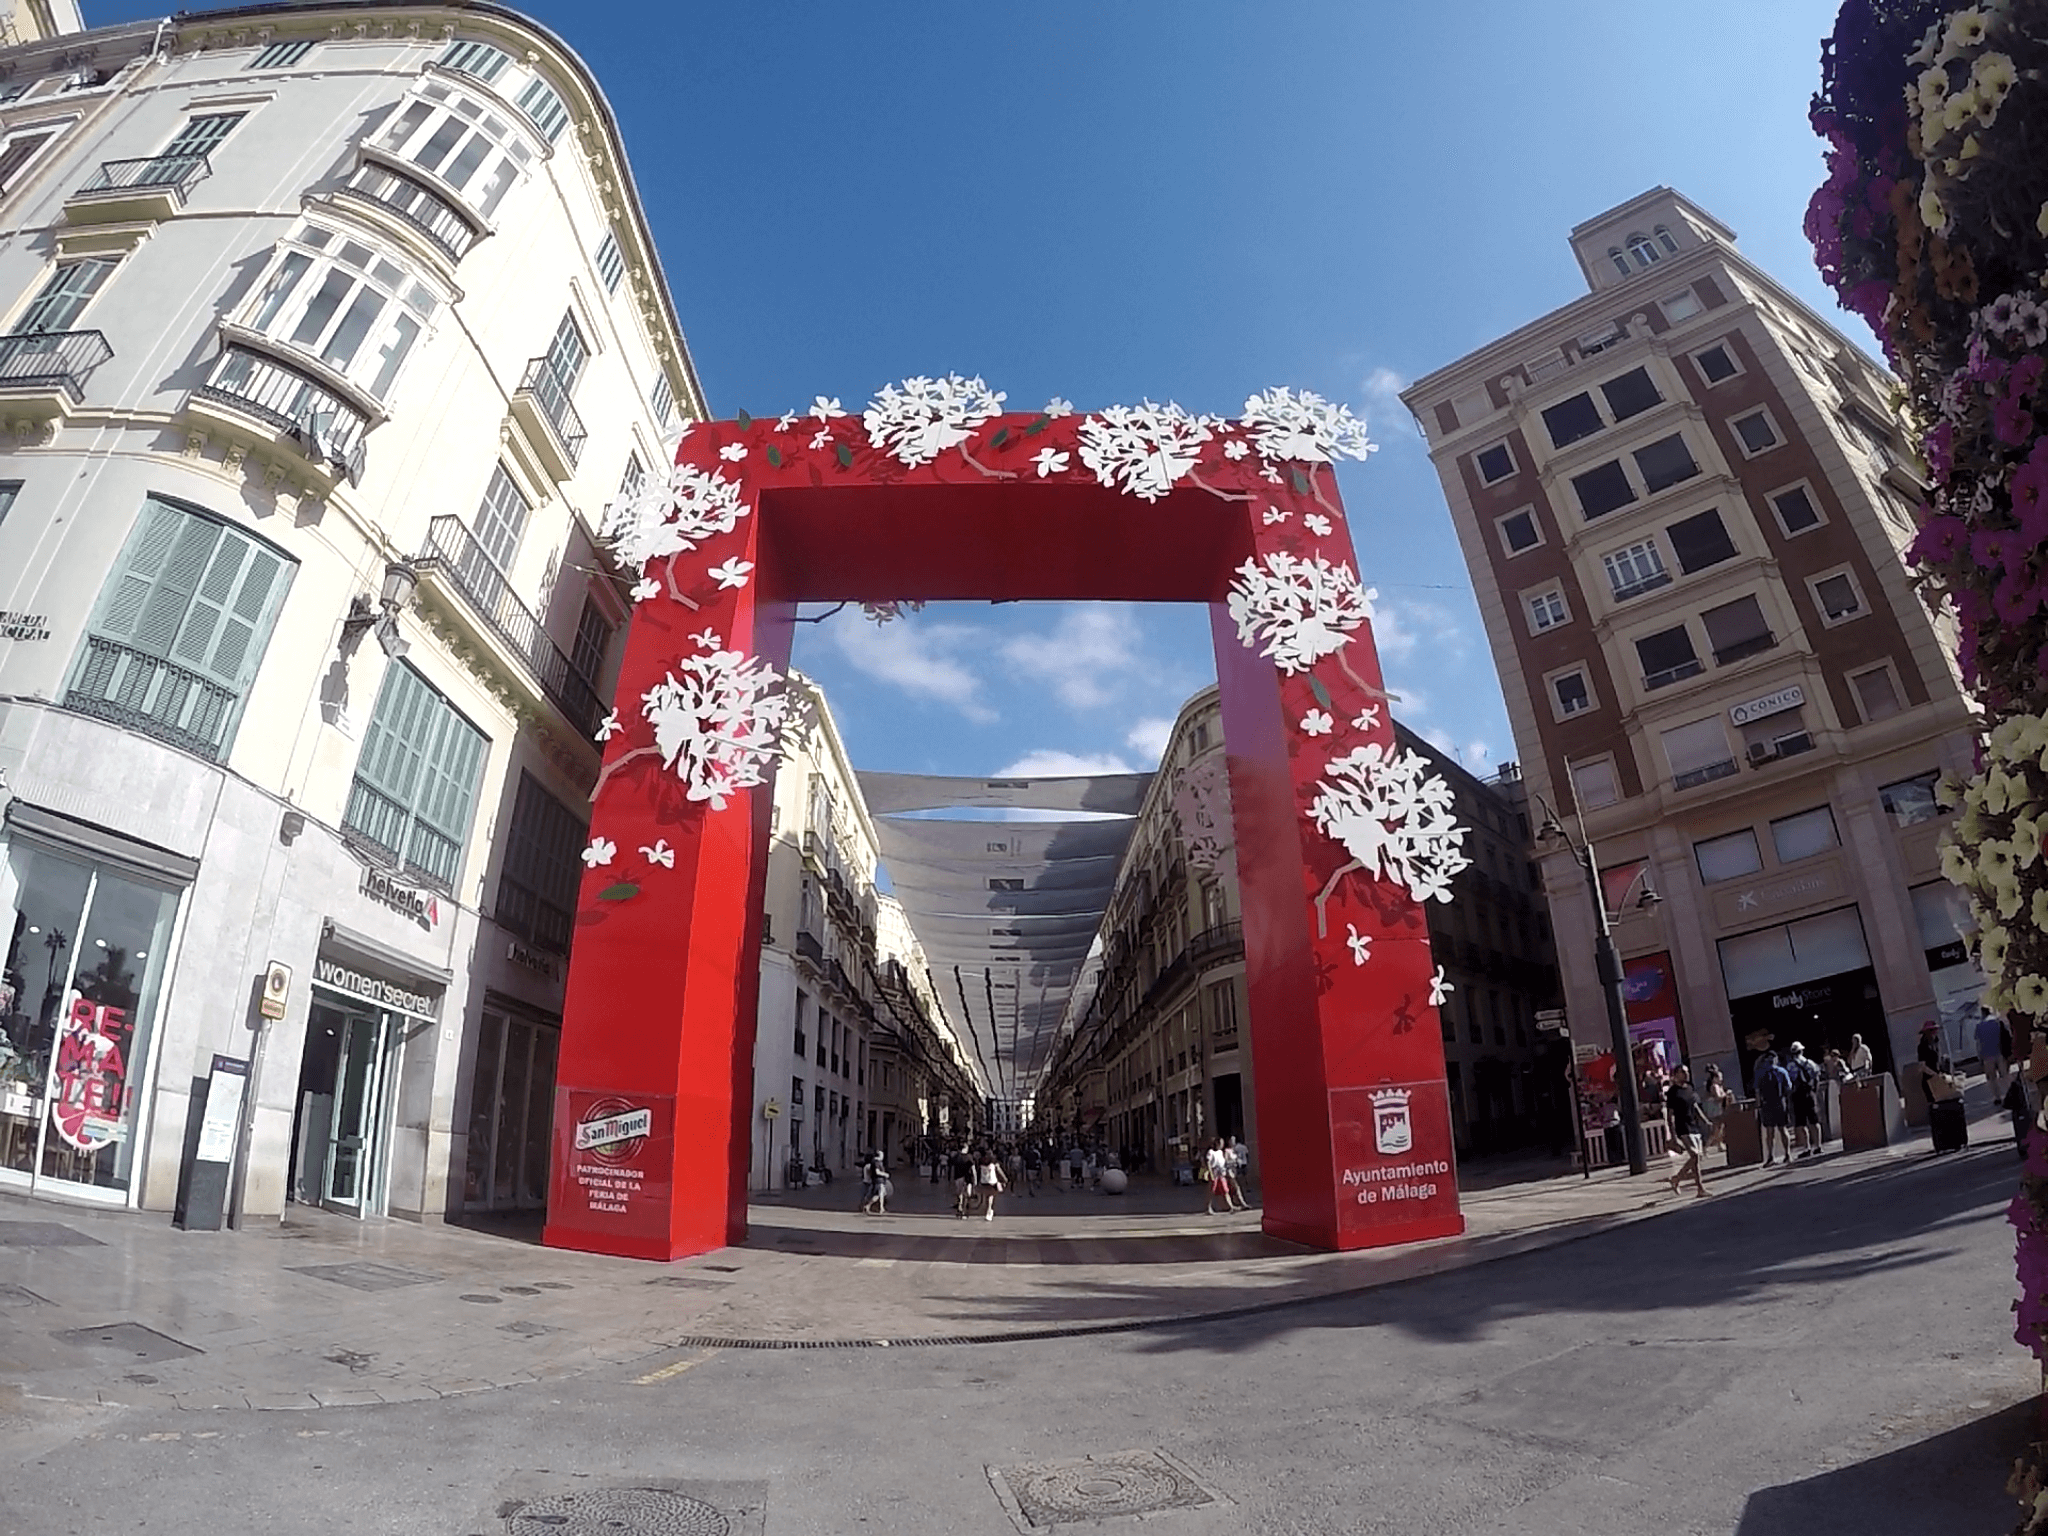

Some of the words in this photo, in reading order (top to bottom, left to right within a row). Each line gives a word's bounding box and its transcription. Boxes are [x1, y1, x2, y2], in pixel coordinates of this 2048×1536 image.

[366, 866, 424, 914] helvetia
[319, 960, 433, 1015] women'secret
[69, 998, 134, 1041] RE-
[58, 1036, 125, 1080] MA
[576, 1164, 644, 1179] PATROCINADOR
[578, 1177, 613, 1189] OFICIAL
[614, 1180, 627, 1189] DE
[628, 1181, 641, 1192] LA
[1342, 1160, 1449, 1187] Ayuntamiento
[588, 1189, 615, 1200] FERIA
[616, 1192, 630, 1201] DE
[1357, 1188, 1378, 1204] de
[1381, 1183, 1437, 1200] Málaga
